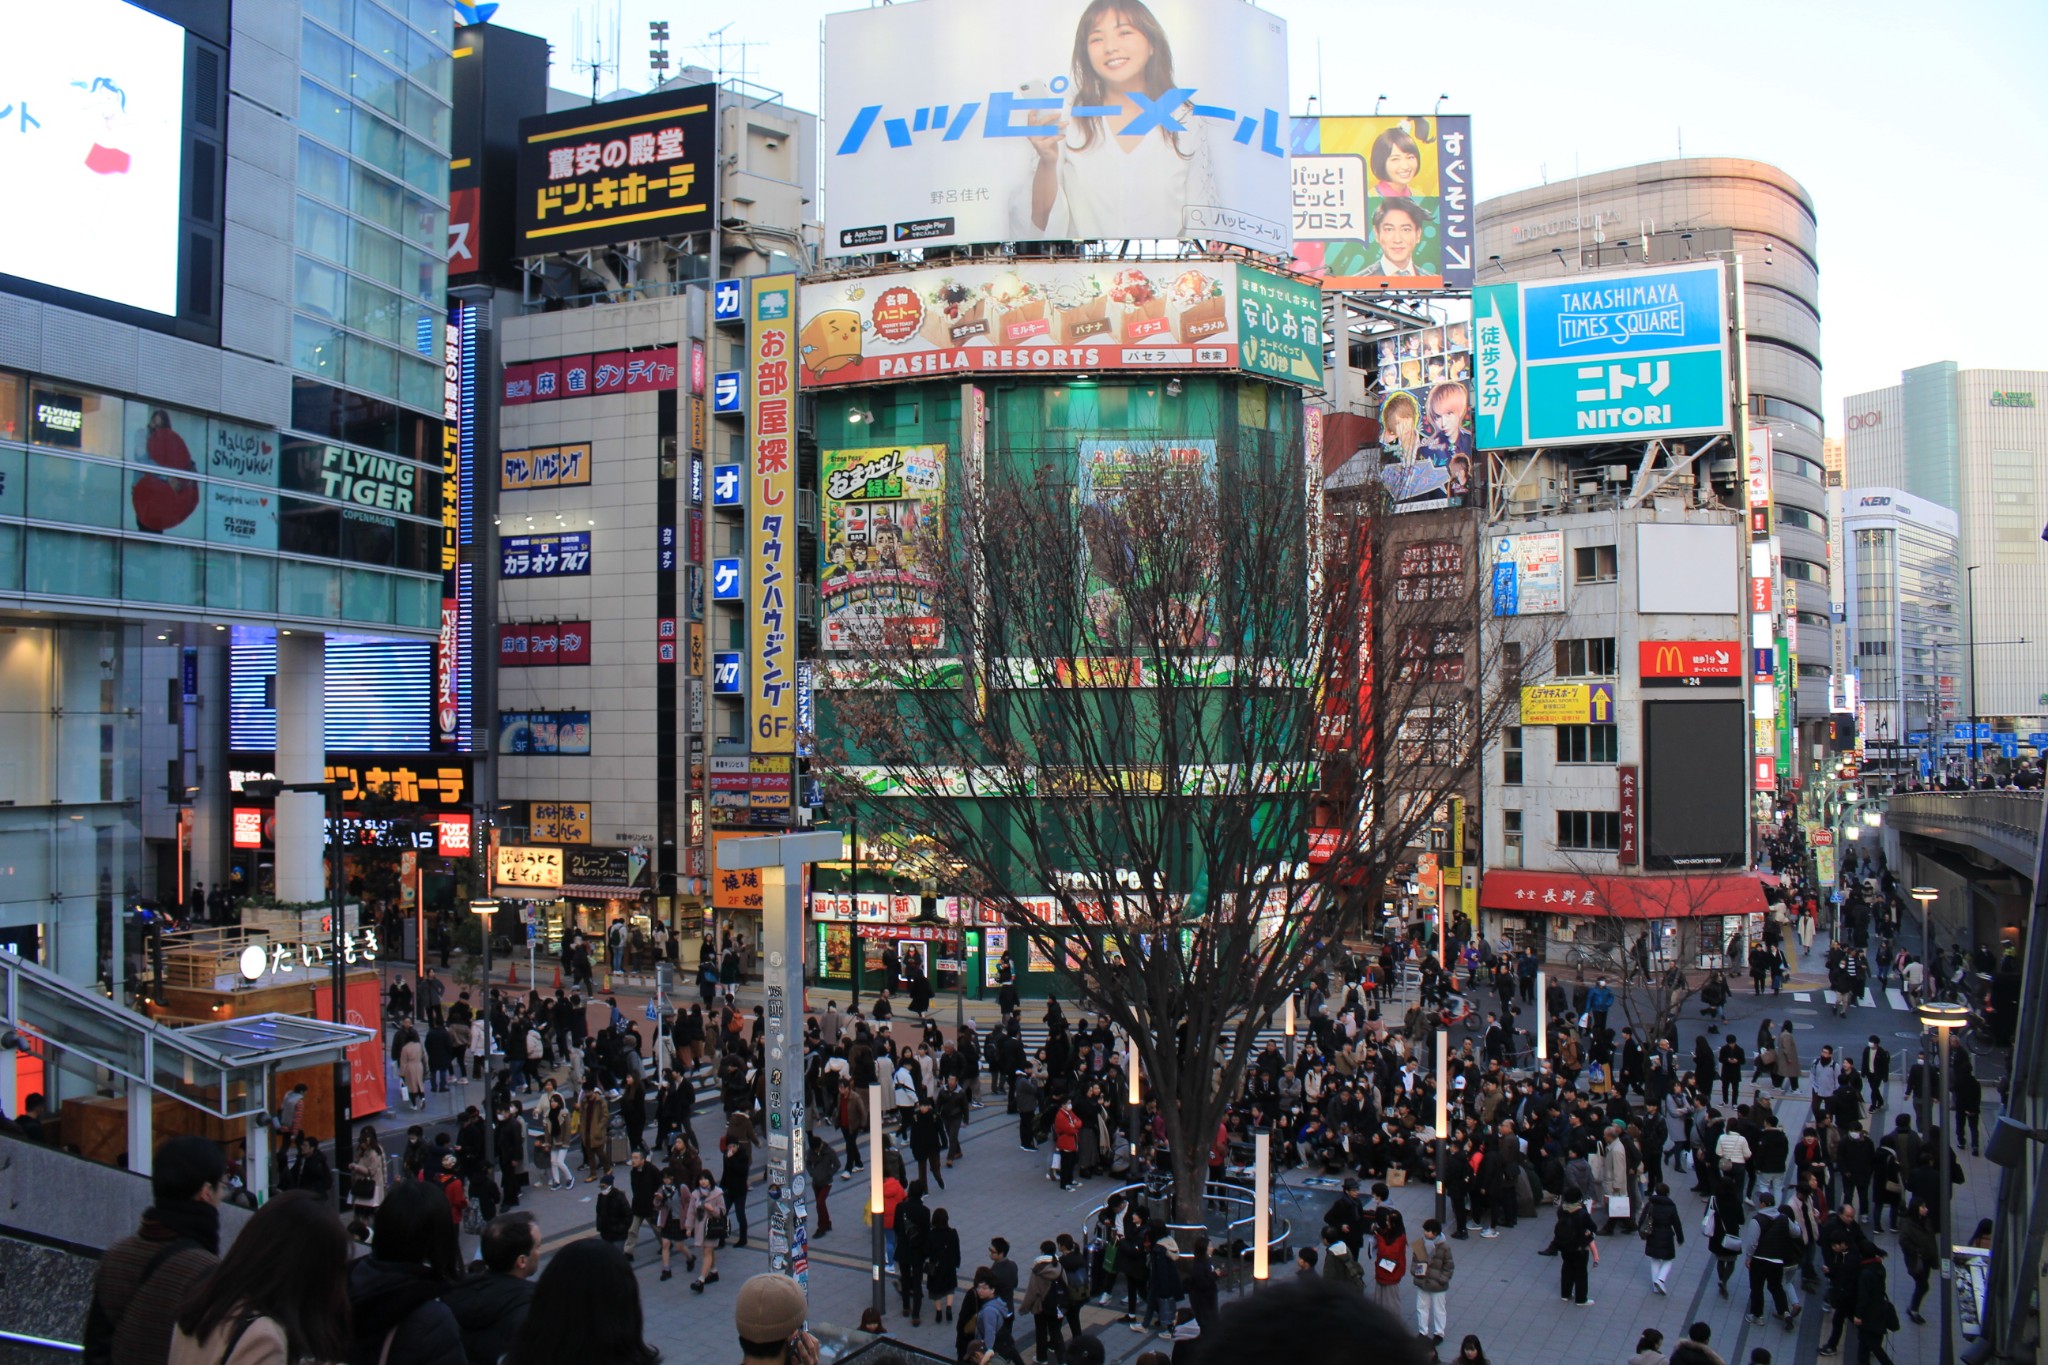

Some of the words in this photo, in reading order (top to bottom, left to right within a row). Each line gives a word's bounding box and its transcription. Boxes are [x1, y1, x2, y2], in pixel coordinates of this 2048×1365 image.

[0, 99, 41, 133] ト
[836, 76, 1285, 158] ハッピーメール
[548, 127, 684, 180] 驚安の殿堂
[930, 187, 990, 205] 野呂佳代
[1443, 131, 1467, 238] すぐそこ
[911, 223, 934, 232] Google
[934, 221, 947, 231] Play
[1215, 213, 1281, 241] ハッピーメール
[1294, 210, 1354, 231] プロミス
[868, 229, 884, 237] Store
[886, 293, 908, 307] 名物
[1561, 282, 1680, 313] TAKASHIMAYA
[953, 323, 985, 338] 生チョコ
[1012, 323, 1045, 335] ミルキー
[1076, 321, 1103, 334] バナナ
[1135, 321, 1162, 334] イチゴ
[1189, 321, 1225, 334] キャラメル
[1242, 298, 1318, 346] 安心お宿
[1562, 316, 1608, 342] TIMES
[1616, 309, 1682, 344] SQUARE
[879, 350, 970, 376] PASELA
[982, 348, 1100, 367] RESORTS
[1201, 351, 1222, 361] 検索
[1260, 350, 1289, 373] 30秒
[1481, 325, 1501, 407] 徒歩2分
[1576, 360, 1671, 402] ニトリ
[38, 404, 82, 420] FLYING
[38, 413, 82, 429] TIGER
[757, 330, 789, 506] お部屋探し
[1577, 404, 1672, 430] NITORI
[323, 446, 415, 486] FLYING
[321, 470, 413, 513] TIGER
[1860, 496, 1891, 507] KEIO
[224, 516, 256, 528] FLYING
[224, 524, 256, 536] TIGER
[342, 509, 395, 528] COPENHAGEN
[662, 527, 672, 569] カラオケ
[1755, 579, 1766, 611] アイフル
[762, 515, 791, 707] タウンハウジング
[661, 620, 675, 660] 麻雀
[714, 663, 738, 684] 747
[1776, 667, 1787, 693] レイク
[758, 714, 789, 738] 6F
[515, 741, 528, 752] 3F
[1622, 773, 1634, 799] 食堂
[1622, 804, 1634, 852] 長野屋
[572, 856, 610, 868] クレープ
[815, 899, 888, 914] 選べるロット
[1514, 889, 1537, 901] 食堂
[1542, 887, 1597, 907] 長野屋
